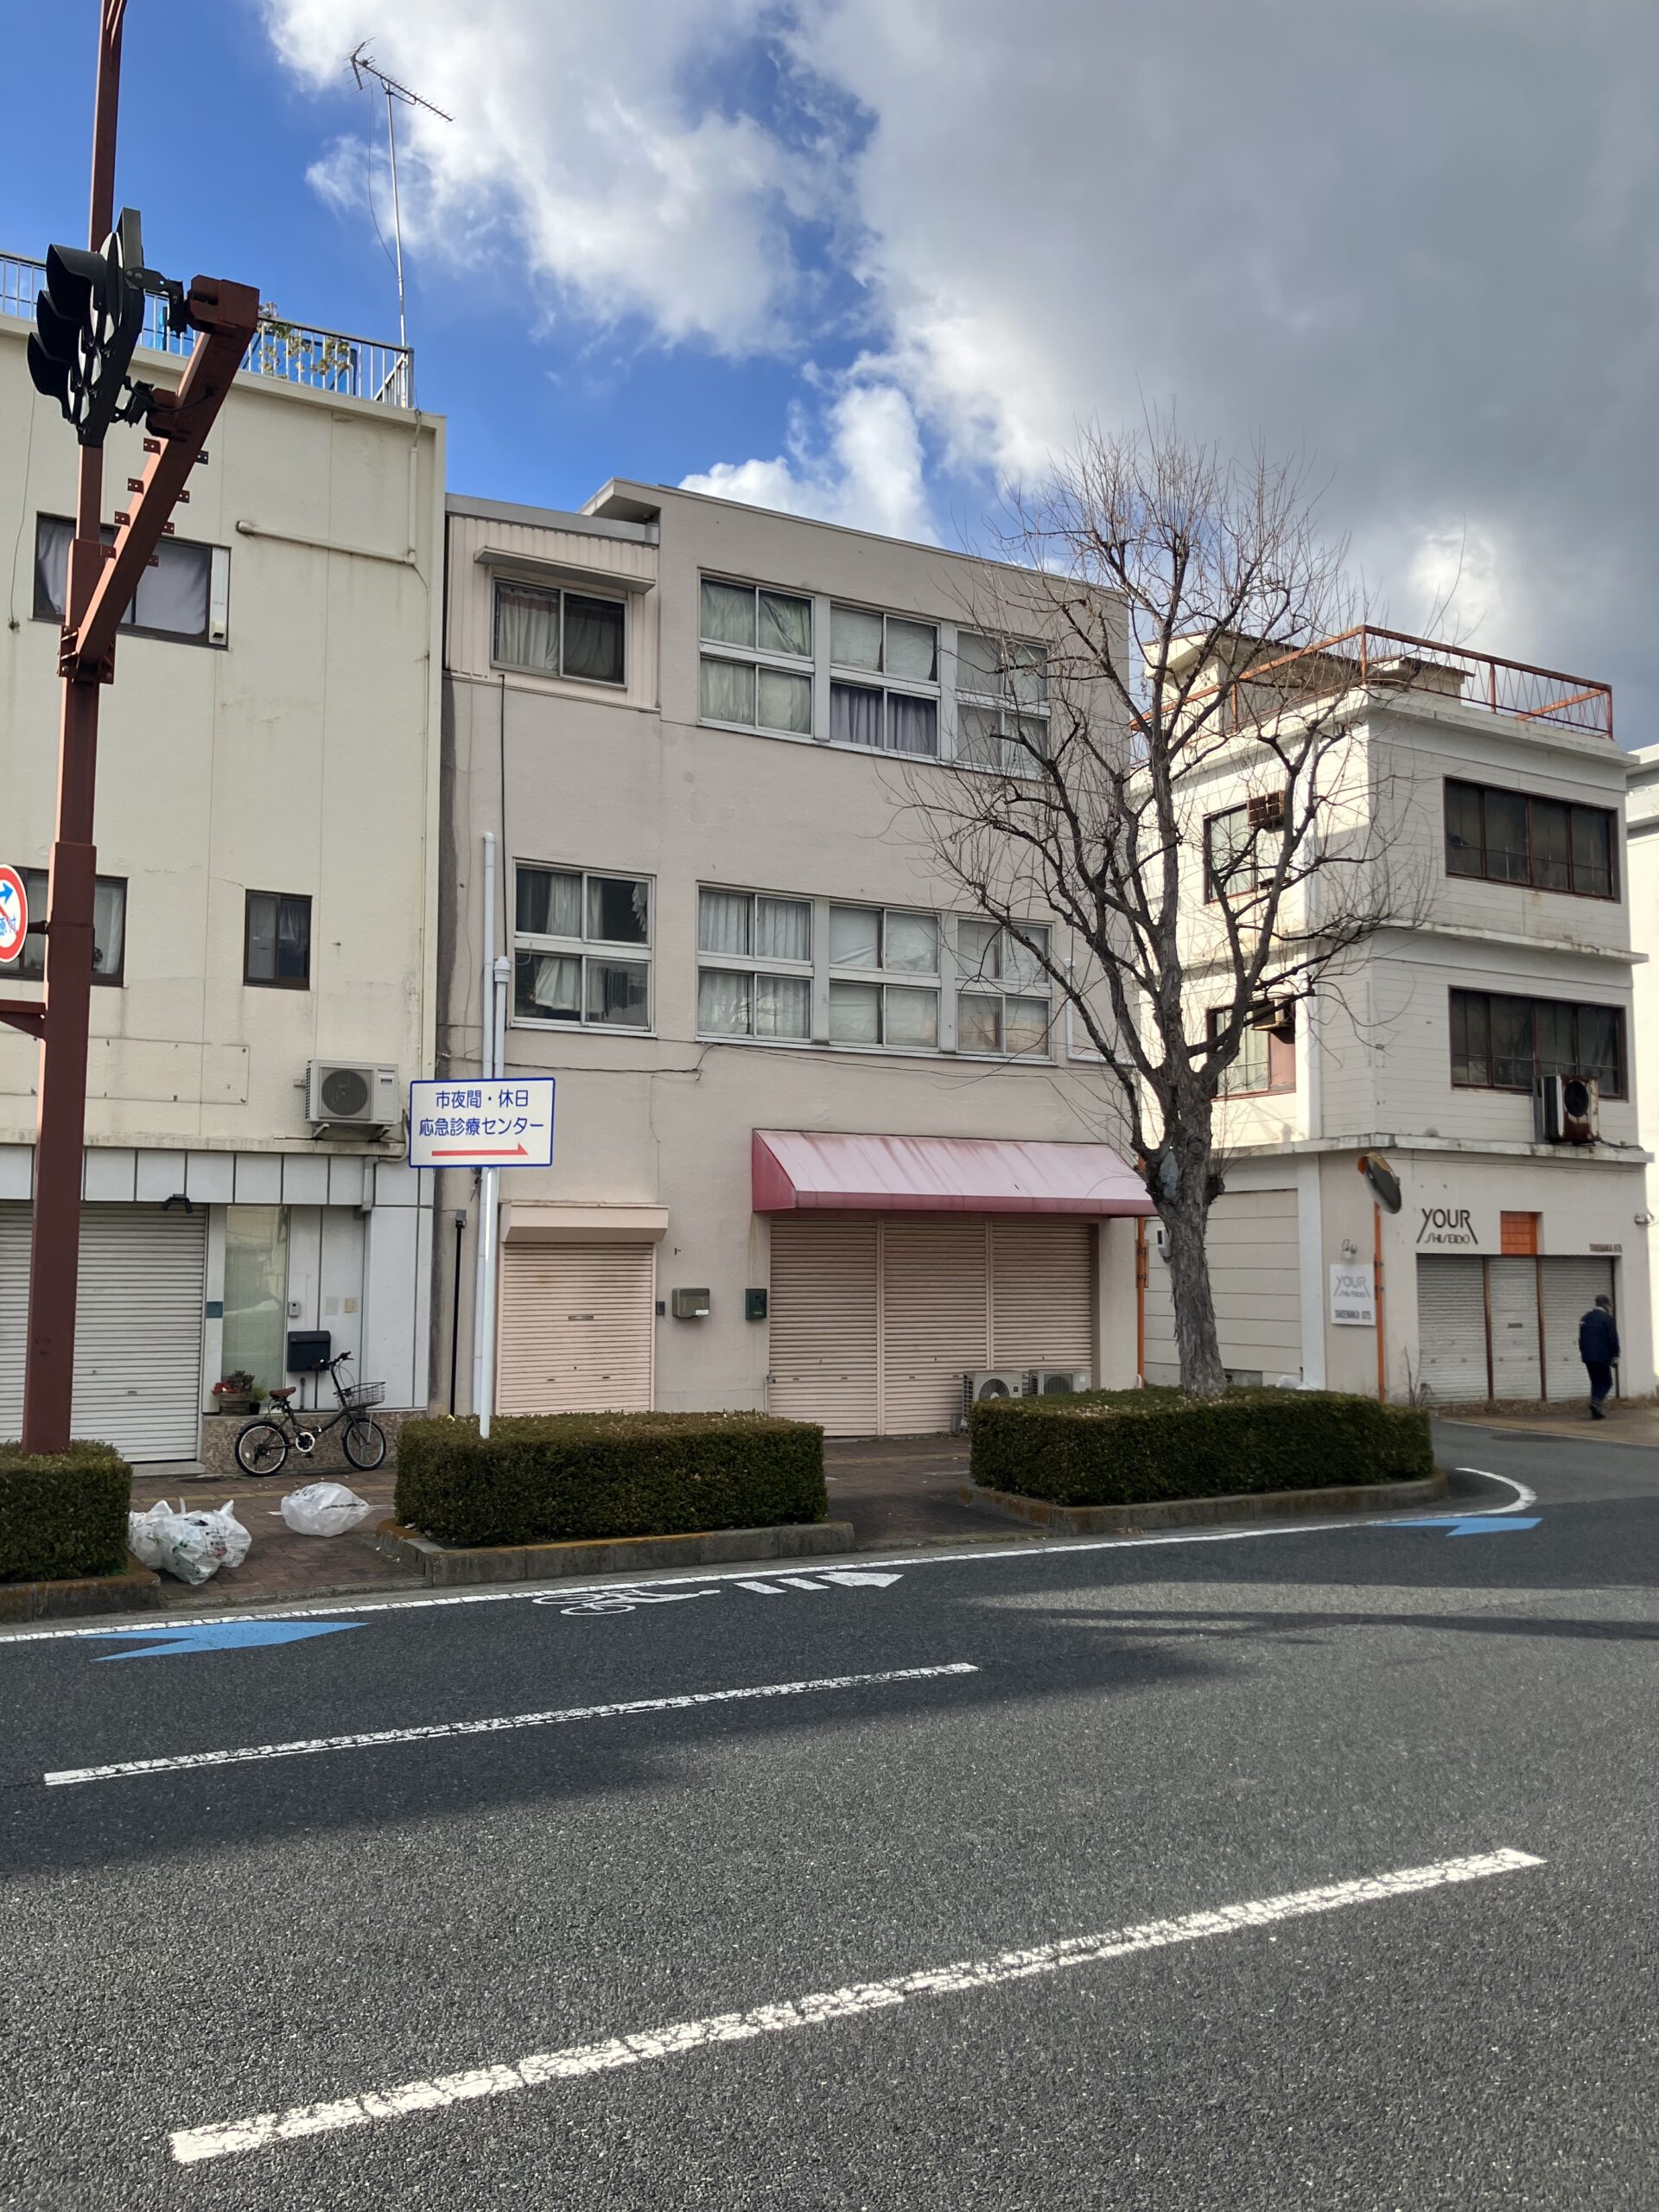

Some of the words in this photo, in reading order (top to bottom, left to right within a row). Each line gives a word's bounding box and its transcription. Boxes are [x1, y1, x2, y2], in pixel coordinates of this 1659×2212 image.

[435, 1090, 529, 1109] 市夜間・休日
[419, 1117, 544, 1137] 応急診療センター
[1416, 1208, 1478, 1244] YOUR
[1424, 1232, 1471, 1244] SHISEIDO
[1333, 1275, 1371, 1298] YOUR
